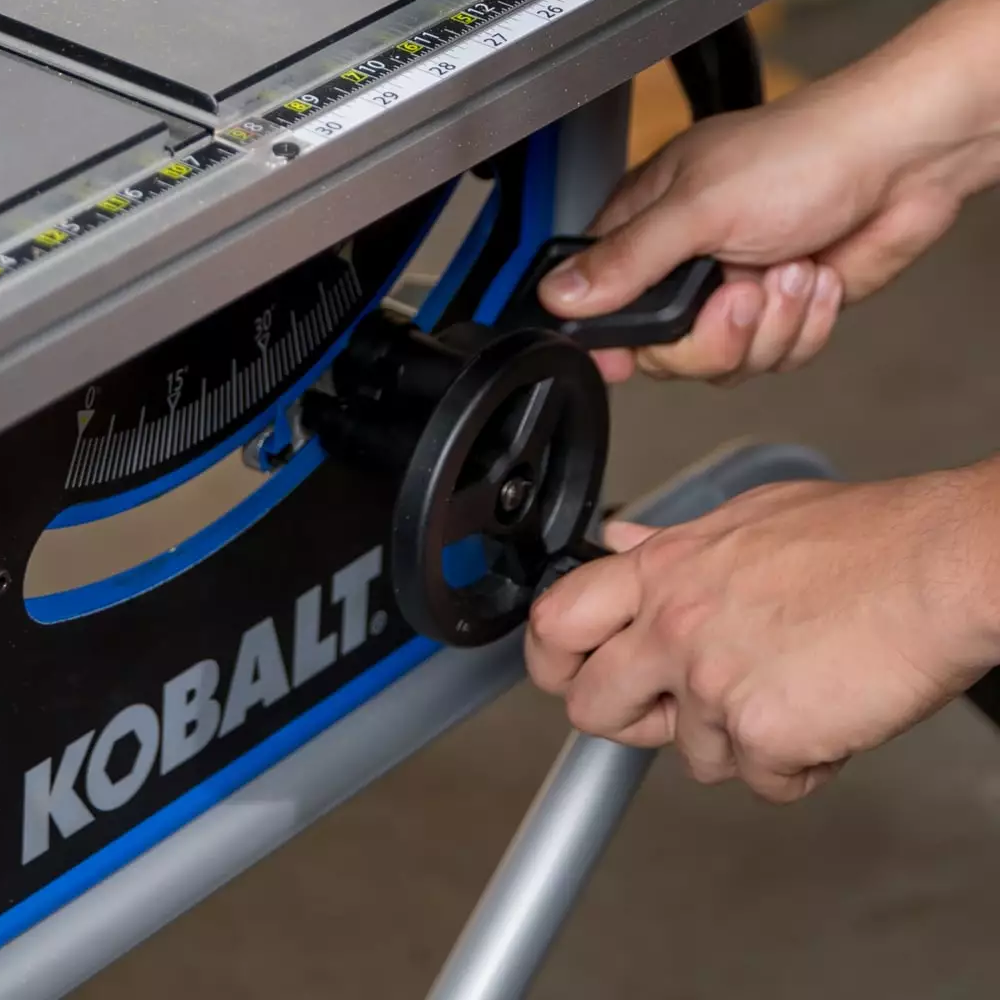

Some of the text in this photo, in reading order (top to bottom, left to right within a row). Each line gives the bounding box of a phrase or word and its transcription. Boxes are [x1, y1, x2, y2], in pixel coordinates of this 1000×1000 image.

[124, 187, 143, 199] 6
[244, 121, 263, 132] 8
[303, 94, 320, 104] 9
[359, 60, 386, 74] 10
[413, 31, 440, 45] 11
[467, 2, 496, 16] 12
[315, 121, 342, 136] 30
[373, 90, 399, 106] 29
[429, 61, 456, 77] 28
[484, 32, 509, 48] 27
[537, 4, 563, 19] 26
[22, 545, 383, 865] KOBALT
